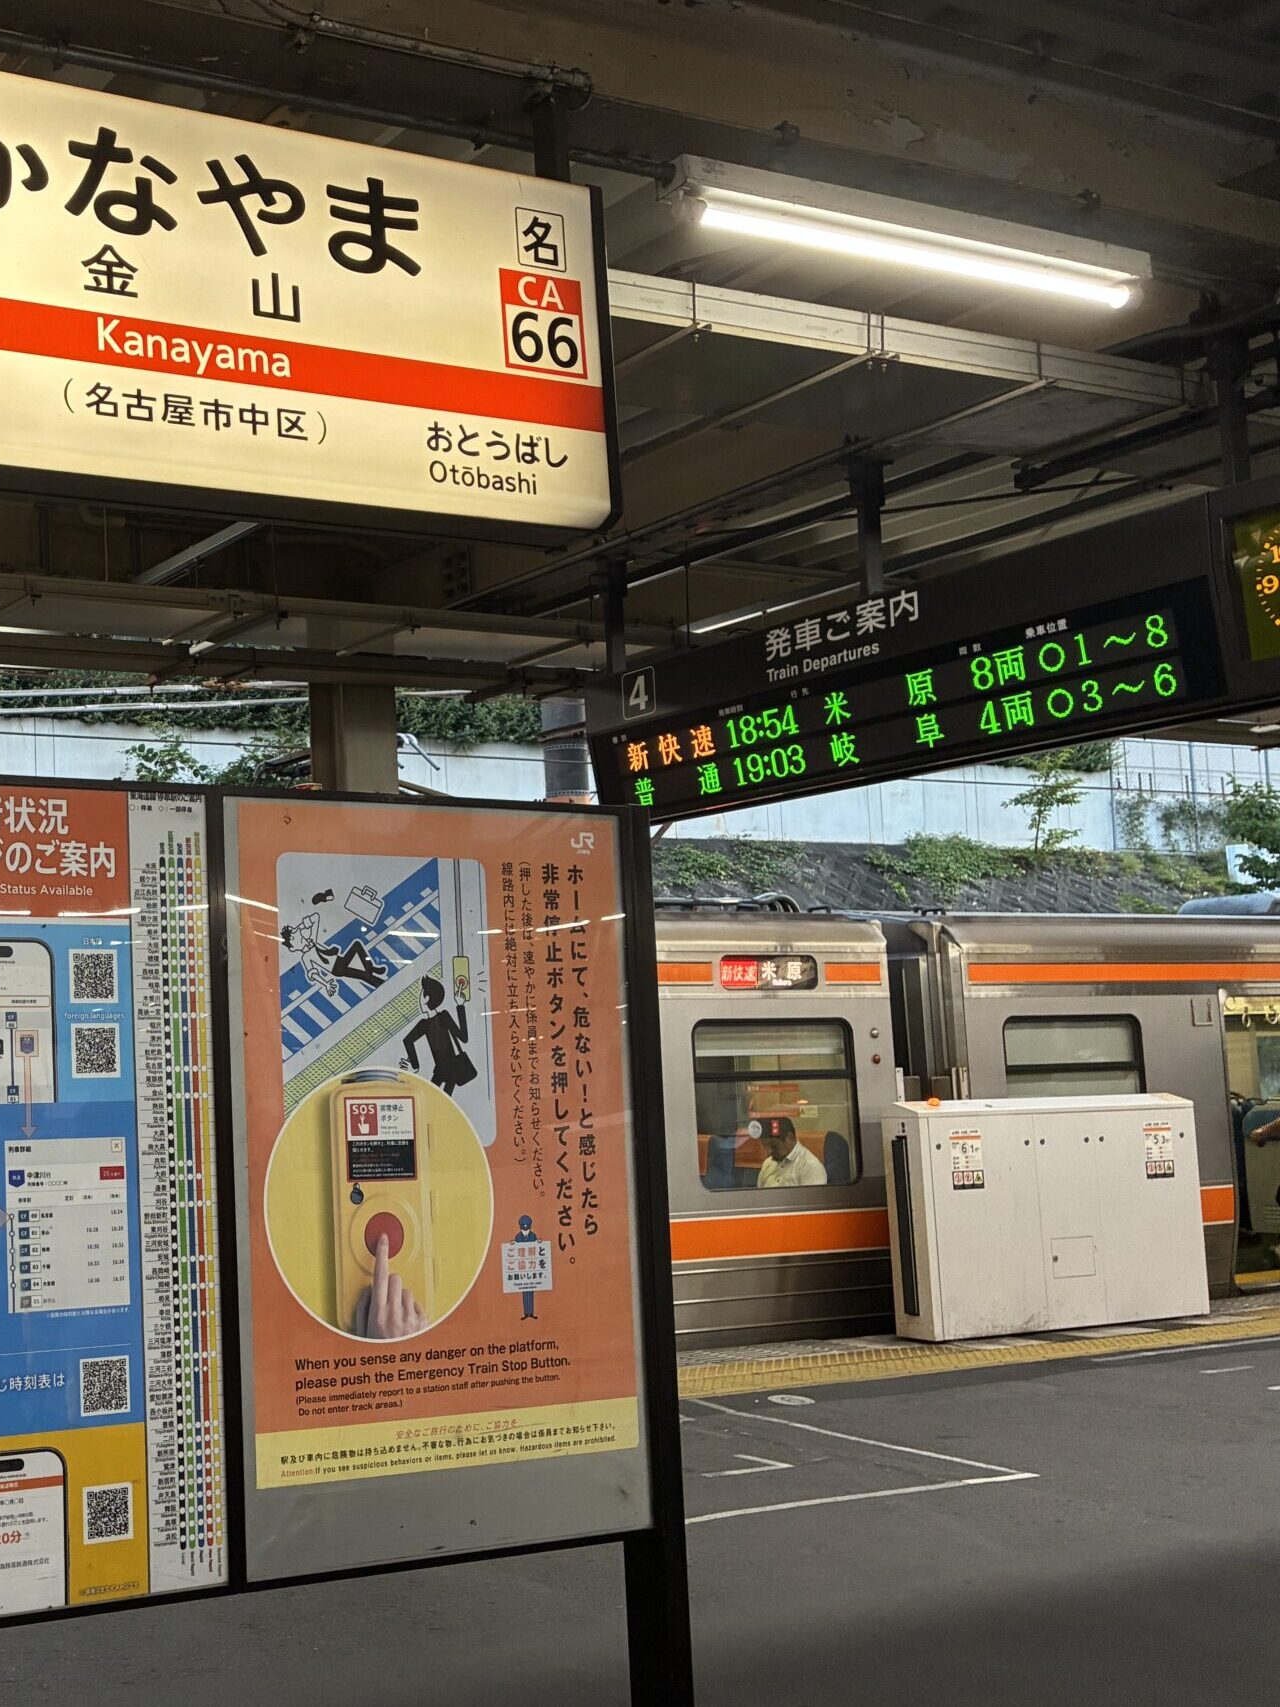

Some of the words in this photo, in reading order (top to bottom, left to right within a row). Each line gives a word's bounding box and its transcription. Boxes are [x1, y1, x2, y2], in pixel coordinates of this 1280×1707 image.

[522, 215, 559, 266] 名
[517, 276, 565, 310] CA
[96, 318, 291, 379] Kanayama
[510, 311, 579, 369] 66
[427, 422, 569, 469] おとうばし
[1262, 575, 1279, 594] 9
[765, 589, 918, 662] 発車ご案内
[1025, 618, 1069, 640] 乗車位置
[766, 664, 799, 683] Train
[803, 642, 880, 674] Departures
[629, 675, 648, 711] 4
[627, 724, 717, 773] 新快速
[727, 704, 799, 749] 18:54
[733, 744, 807, 787] 19:03
[41, 884, 93, 896] Available
[64, 1012, 88, 1022] foreign
[90, 1012, 125, 1022] languages
[352, 1104, 375, 1115] SOS
[295, 1357, 329, 1371] When
[333, 1357, 357, 1370] you
[360, 1354, 396, 1366] sense
[400, 1351, 422, 1363] any
[425, 1348, 467, 1361] danger
[470, 1346, 484, 1356] on
[487, 1343, 506, 1355] the
[509, 1339, 559, 1355] platform,
[295, 1377, 337, 1391] please
[341, 1372, 370, 1387] push
[374, 1371, 394, 1383] the
[398, 1366, 464, 1381] Emergency
[468, 1362, 498, 1375] Train
[502, 1360, 527, 1372] Stop
[531, 1357, 571, 1369] Button.
[296, 1394, 327, 1406] (Please
[328, 1390, 377, 1402] immediately
[379, 1387, 404, 1398] report
[406, 1387, 414, 1395] to
[423, 1383, 450, 1393] station
[451, 1381, 468, 1391] staff
[470, 1380, 489, 1389] after
[491, 1377, 520, 1388] pushing
[521, 1376, 533, 1384] the
[535, 1374, 560, 1383] button.
[298, 1407, 310, 1417] Do
[312, 1406, 325, 1415] not
[327, 1404, 349, 1414] enter
[352, 1402, 373, 1412] track
[375, 1399, 403, 1410] areas.)
